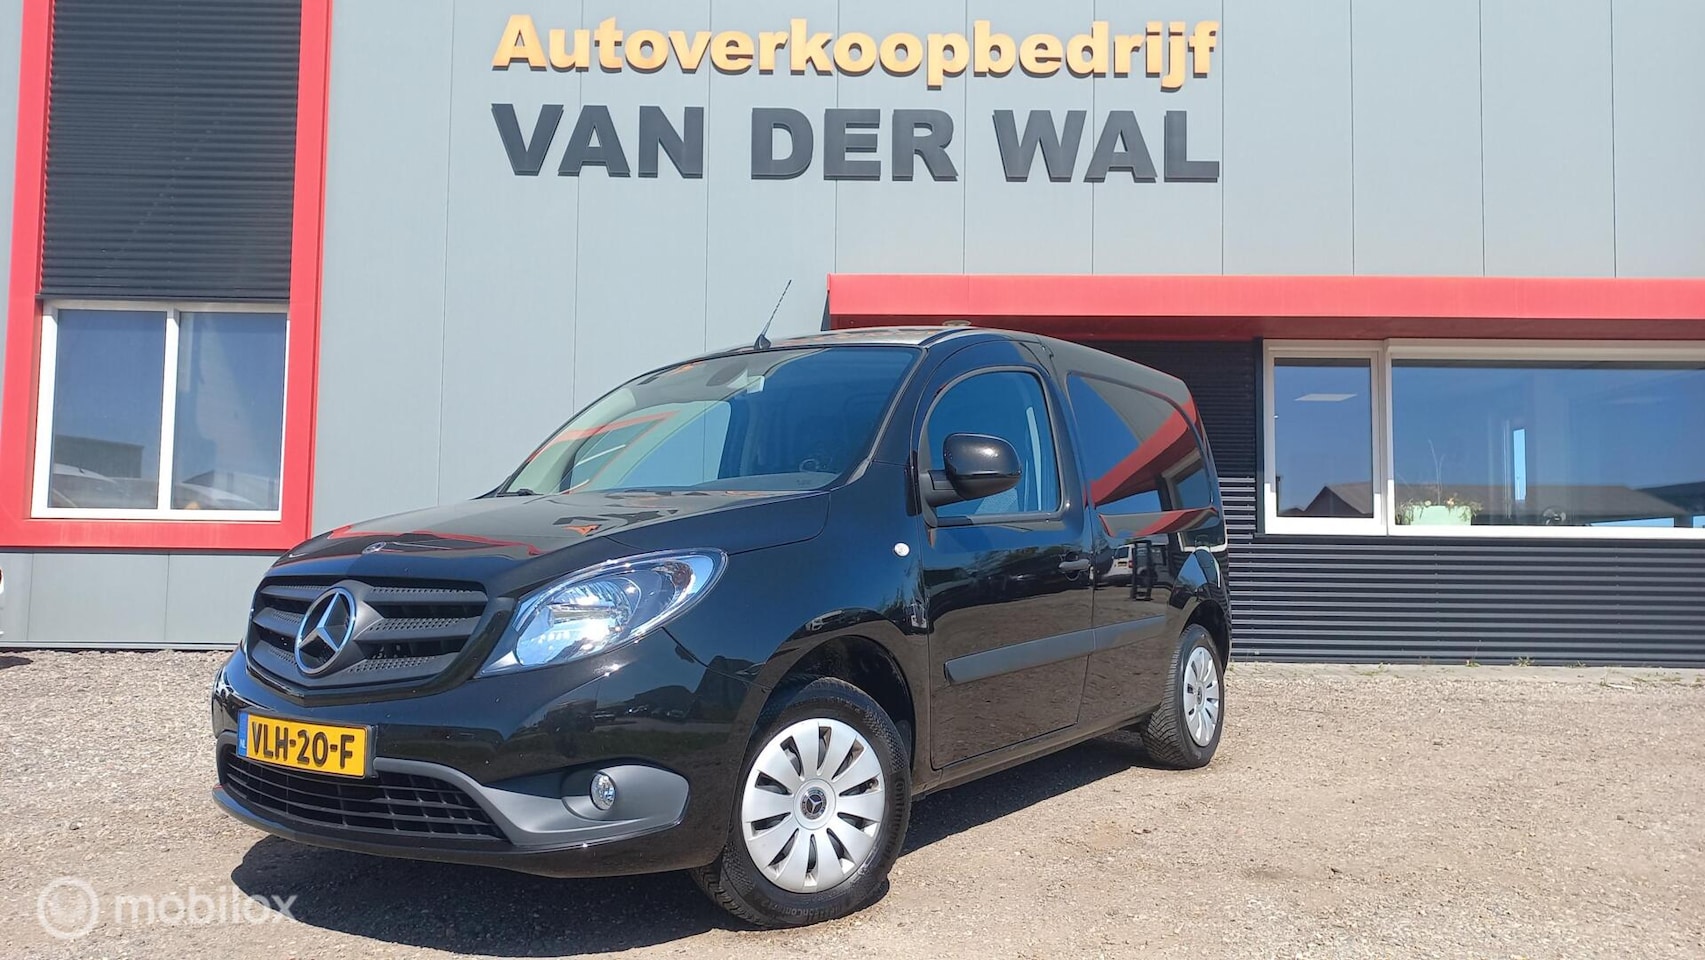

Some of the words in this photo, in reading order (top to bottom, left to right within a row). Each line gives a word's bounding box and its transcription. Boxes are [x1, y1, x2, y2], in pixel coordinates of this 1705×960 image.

[491, 14, 1218, 91] Autoverkoopbedrijf
[491, 103, 704, 179] VAN
[750, 107, 959, 182] DER
[992, 109, 1220, 183] WAL
[251, 720, 355, 770] VLH-20-F
